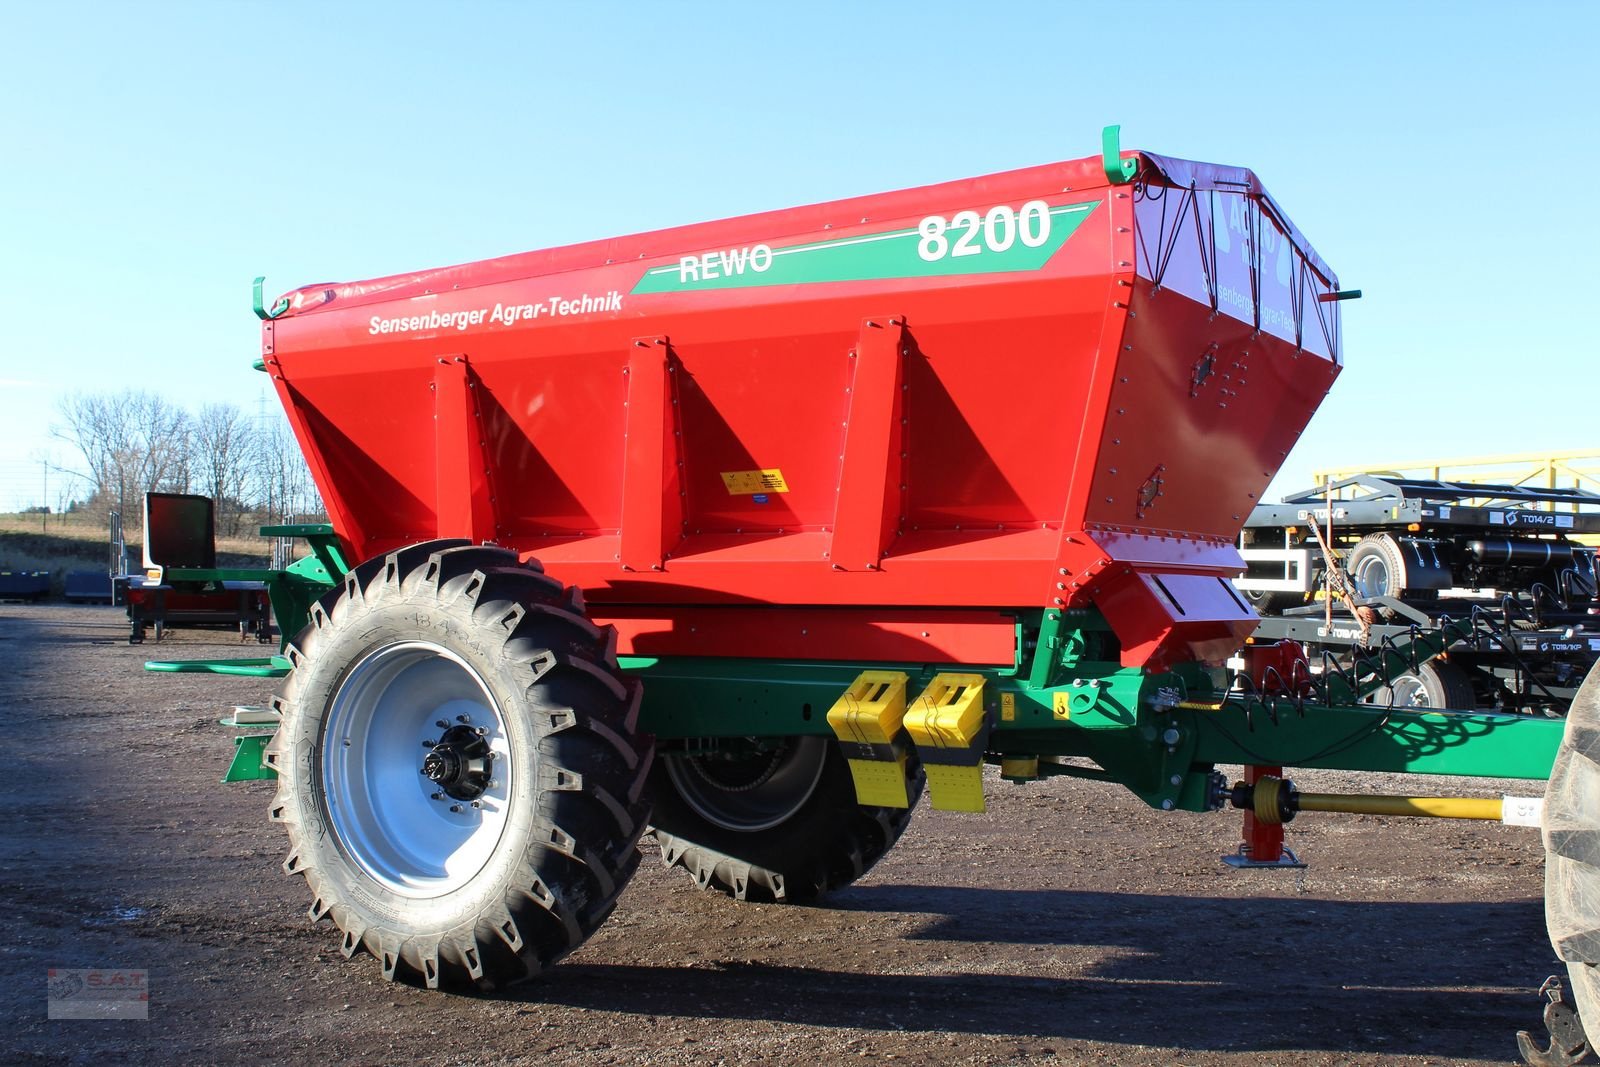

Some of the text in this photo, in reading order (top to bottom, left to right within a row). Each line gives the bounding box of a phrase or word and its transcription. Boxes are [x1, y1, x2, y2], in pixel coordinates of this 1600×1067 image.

[917, 200, 1051, 262] 8200
[679, 244, 773, 283] REWO
[368, 291, 623, 335] Sensenberger Agrar-Technik
[1202, 273, 1256, 317] Ssenberge
[1313, 508, 1345, 519] T0/2
[1522, 514, 1554, 524] T014/2
